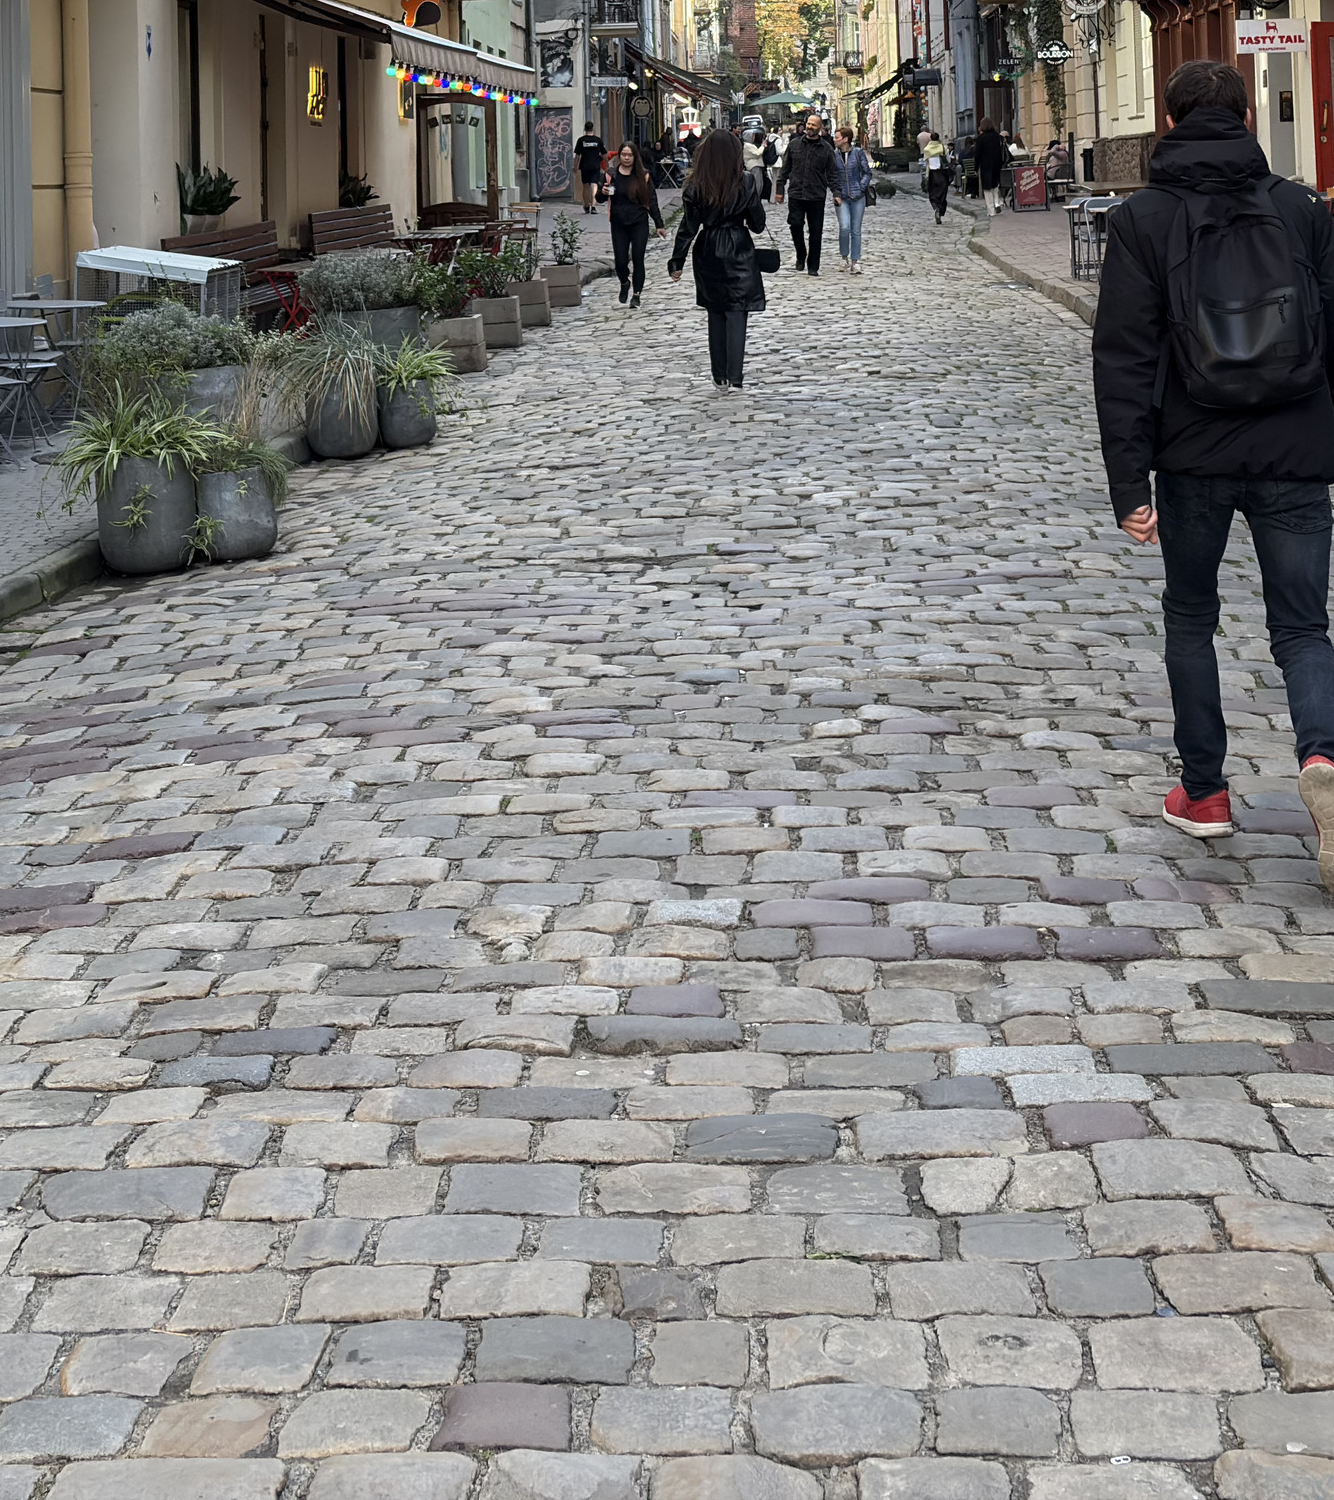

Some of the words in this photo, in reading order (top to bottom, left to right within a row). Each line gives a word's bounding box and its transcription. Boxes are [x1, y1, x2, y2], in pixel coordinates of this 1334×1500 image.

[1238, 35, 1276, 45] TASTY
[1278, 34, 1305, 44] TAIL
[1037, 50, 1074, 59] BOURBON
